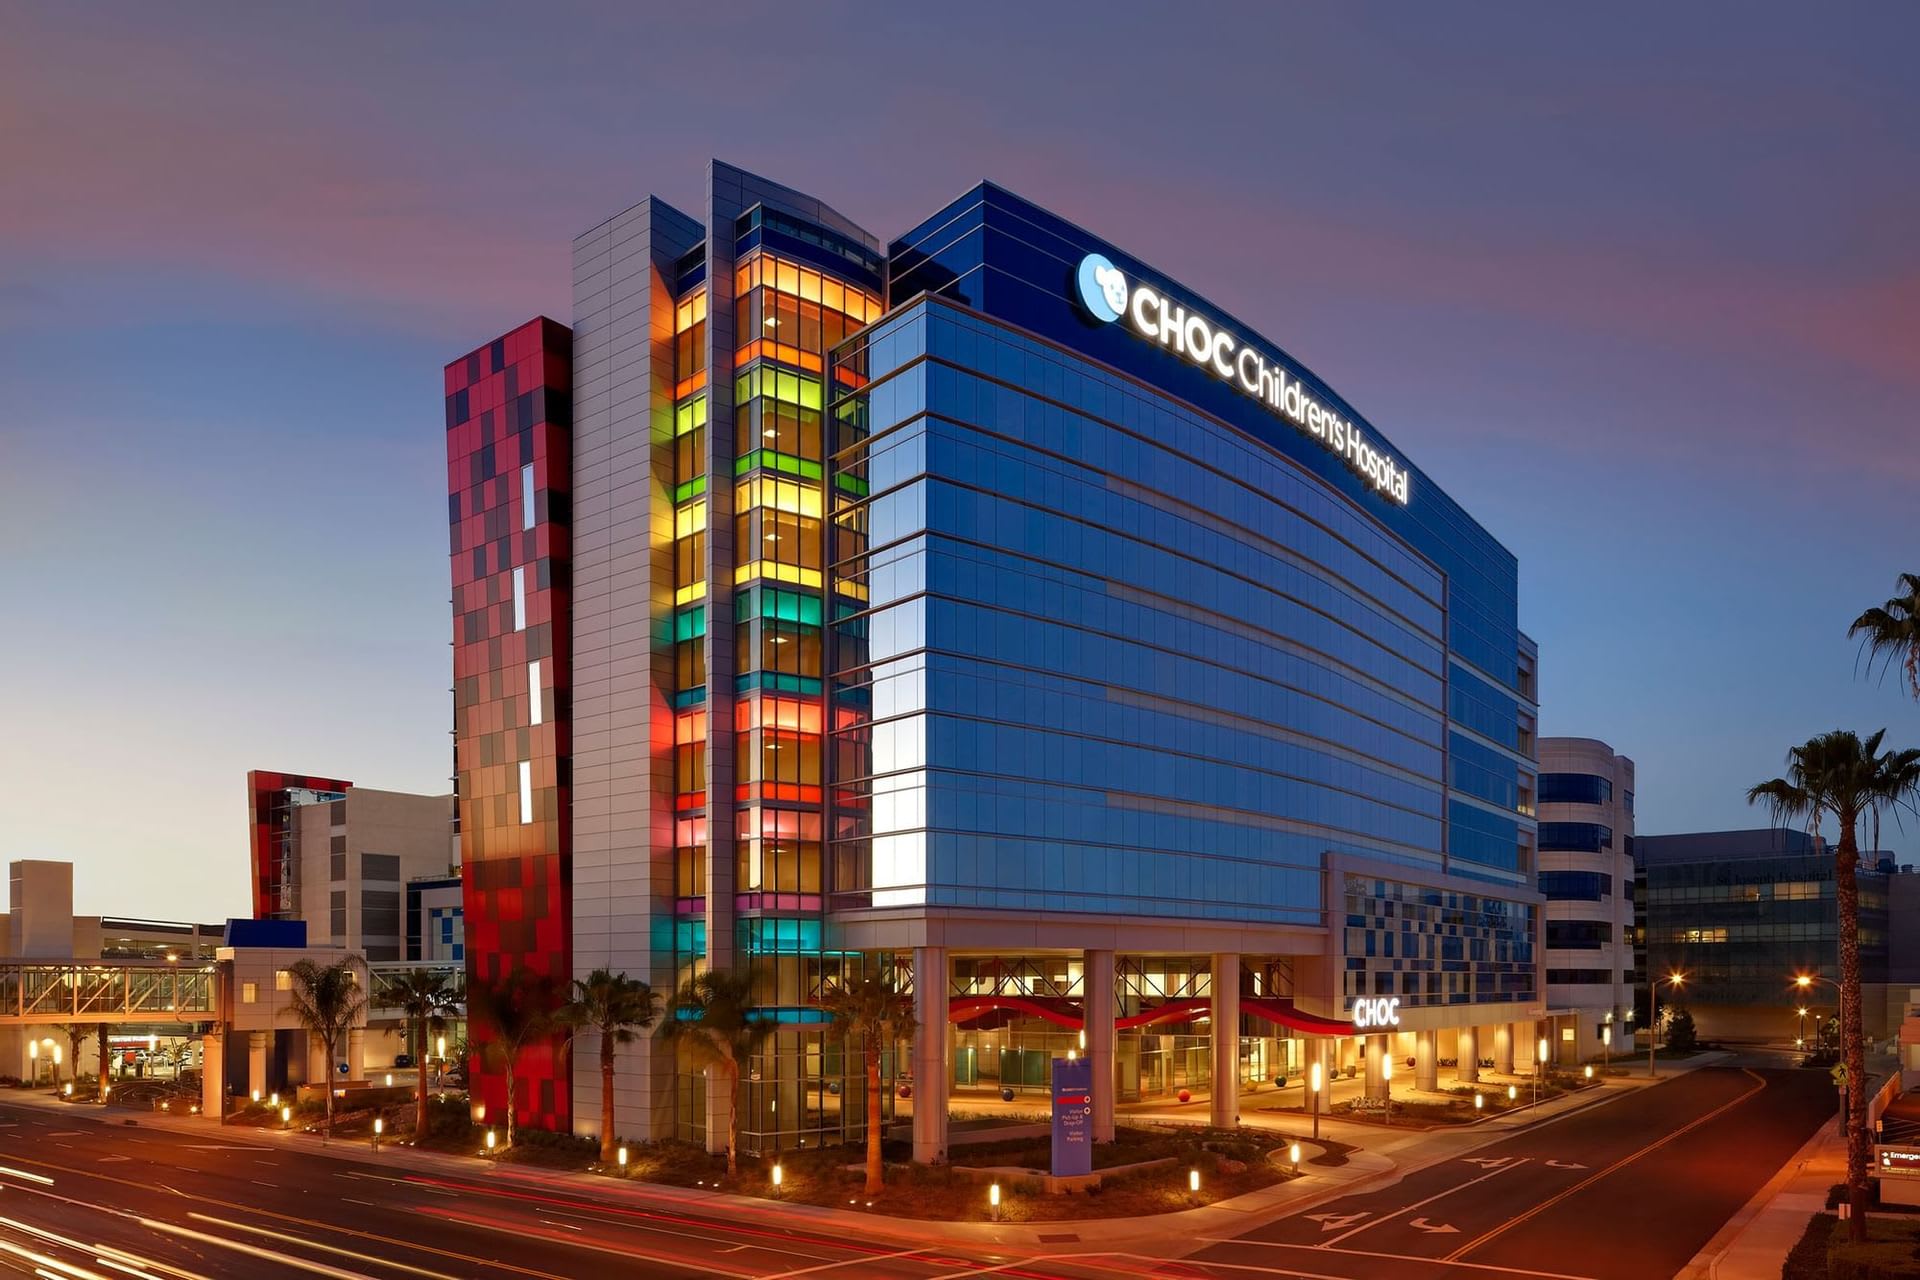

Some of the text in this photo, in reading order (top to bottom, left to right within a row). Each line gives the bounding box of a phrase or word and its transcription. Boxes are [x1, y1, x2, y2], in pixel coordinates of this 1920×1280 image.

[1132, 287, 1407, 505] CHOC Children's Hospital
[1779, 868, 1832, 882] Hospital
[1354, 998, 1400, 1027] CHOC
